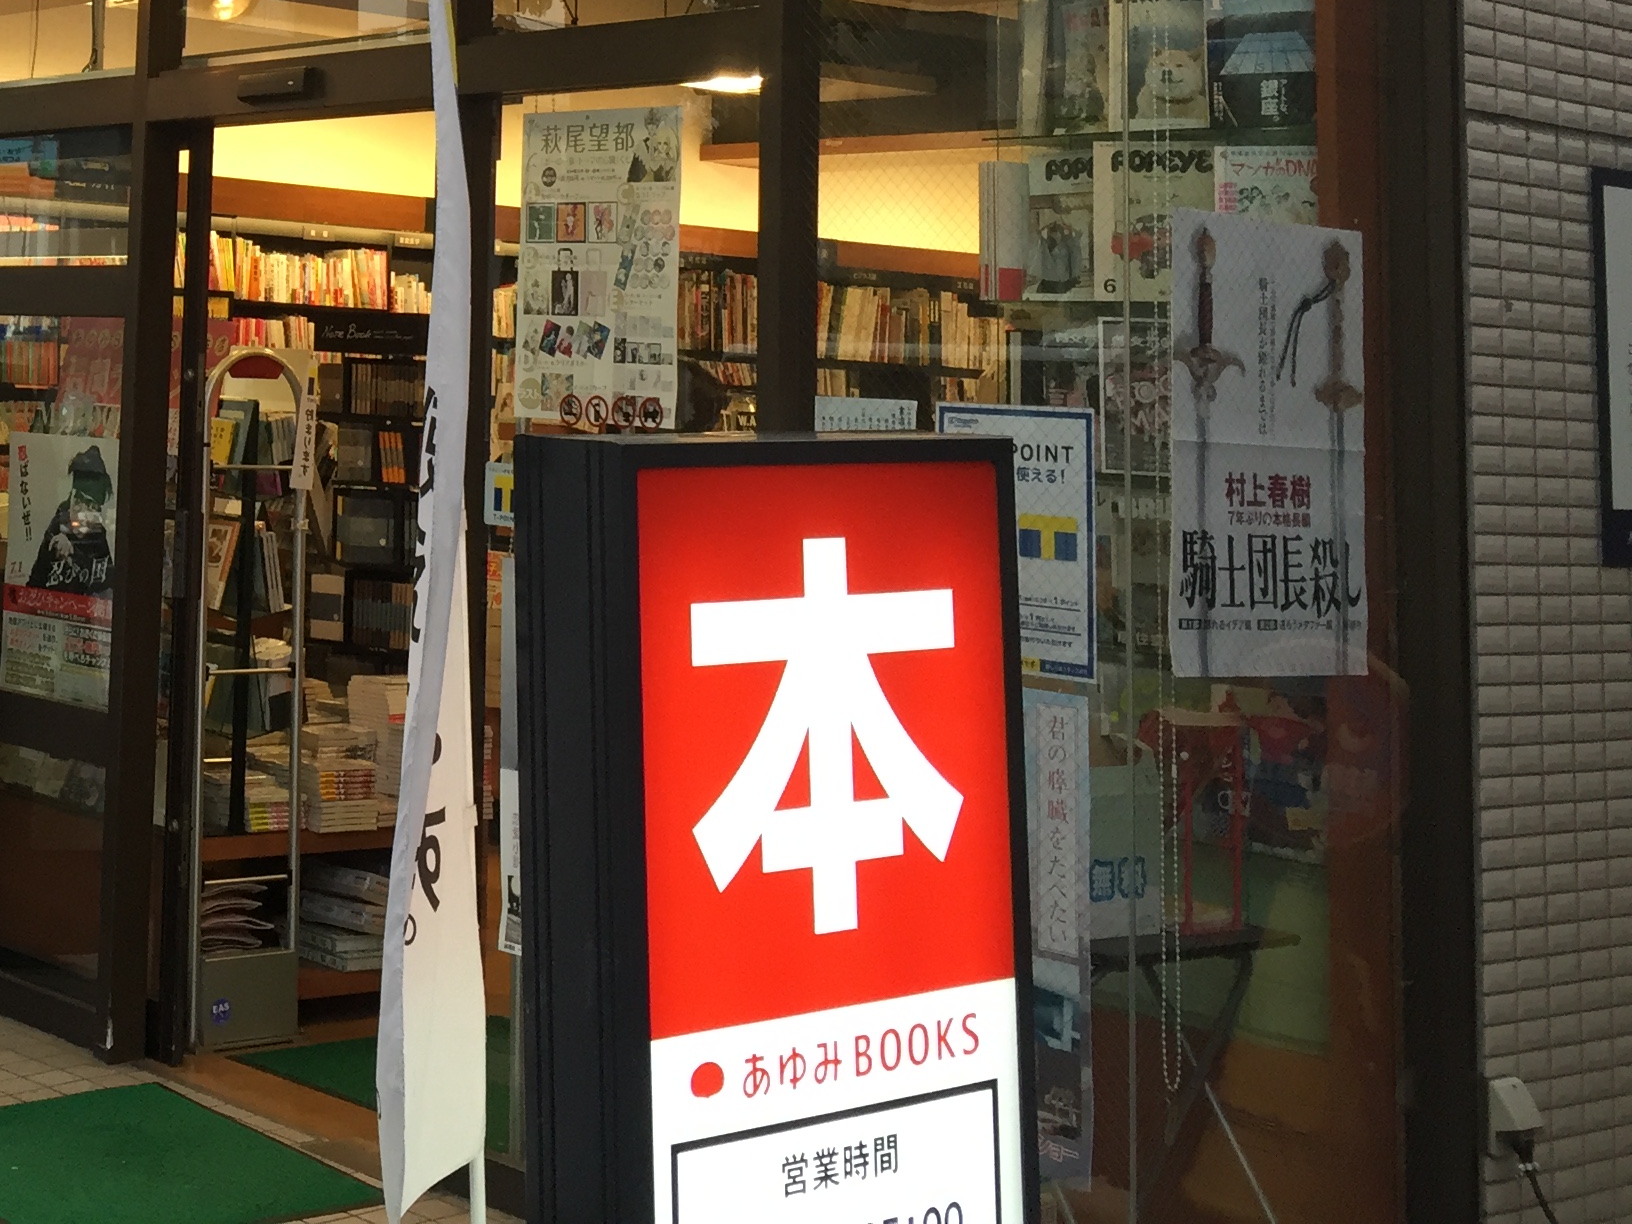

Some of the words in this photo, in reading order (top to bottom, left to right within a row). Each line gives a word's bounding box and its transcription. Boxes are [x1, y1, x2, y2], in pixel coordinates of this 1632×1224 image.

[541, 122, 635, 155] 萩尾望都
[1111, 149, 1215, 174] POPEYE
[1103, 278, 1117, 294] 6
[1016, 465, 1066, 484] 使える!
[1224, 471, 1312, 510] 村上春樹
[1179, 529, 1363, 619] 騎士団長殺し
[691, 536, 965, 936] 本
[1043, 713, 1070, 945] 君の膵臓をたべたい
[212, 998, 231, 1014] EAS
[742, 1012, 982, 1099] あゆみBOOKS
[781, 1132, 900, 1198] 営業時間
